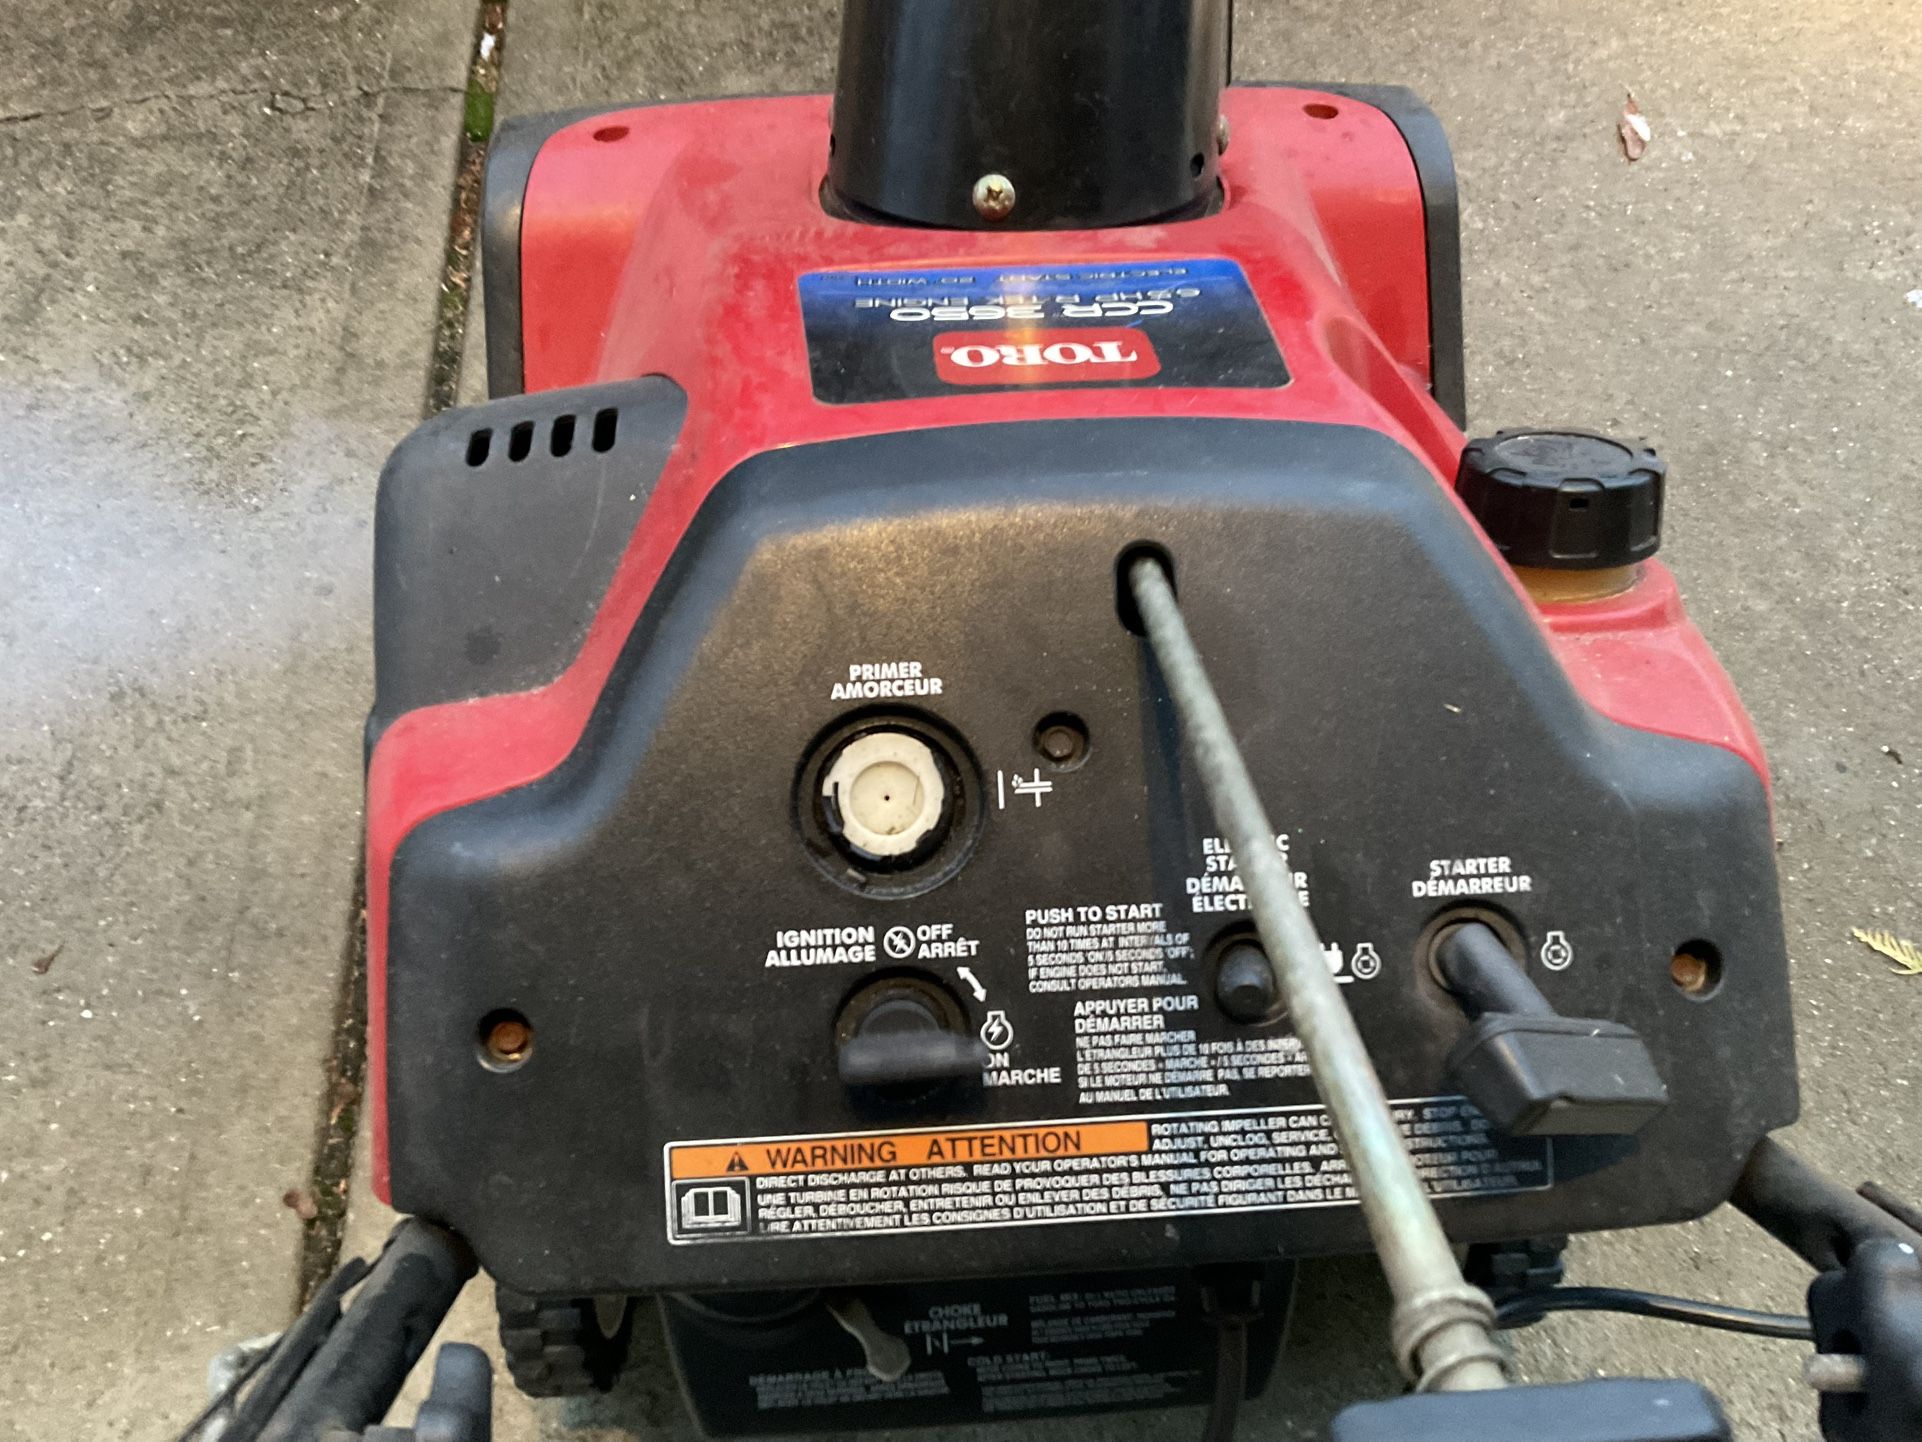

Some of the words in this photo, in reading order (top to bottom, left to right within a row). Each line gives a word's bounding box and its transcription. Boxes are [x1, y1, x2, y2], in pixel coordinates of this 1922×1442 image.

[855, 297, 969, 308] ENGINE
[1061, 300, 1173, 317] CCR
[889, 305, 1045, 321] 3650
[950, 341, 1138, 367] TORO
[849, 662, 922, 681] PRIMER
[830, 678, 943, 700] AMORCEUR
[1429, 856, 1512, 877] STARTER
[1412, 873, 1532, 898] DÉMARREUR
[1025, 908, 1075, 925] PUSH
[1077, 906, 1103, 922] TO
[1105, 903, 1164, 921] START
[776, 926, 875, 949] IGNITION
[916, 924, 954, 942] OFF
[1026, 927, 1042, 940] DO
[1043, 926, 1064, 939] NOT
[1066, 924, 1088, 938] RUN
[1089, 922, 1136, 937] STARTER
[1137, 921, 1167, 935] MORE
[764, 942, 877, 967] ALLUMAGE
[917, 937, 980, 960] ARRÊT
[1027, 940, 1055, 953] THAN
[1057, 939, 1068, 951] 10
[1069, 937, 1099, 951] TIMES
[1101, 937, 1115, 949] AT
[1175, 932, 1190, 946] OF
[1036, 951, 1085, 967] SECONDS
[1115, 947, 1164, 962] SECONDS
[1028, 968, 1038, 980] IF
[1039, 965, 1078, 979] ENGINE
[1078, 963, 1107, 976] DOES
[1108, 962, 1130, 975] NOT
[1029, 979, 1077, 993] CONSULT
[1074, 998, 1149, 1017] APPUYER
[1153, 995, 1199, 1012] POUR
[1075, 1014, 1165, 1034] DÉMARRER
[1092, 1034, 1113, 1047] PAS
[1114, 1033, 1144, 1046] FAIRE
[1145, 1030, 1196, 1044] MARCHER
[1211, 1041, 1235, 1055] FOIS
[1101, 1059, 1156, 1074] SECONDES
[983, 1069, 1062, 1088] MARCHE
[1090, 1075, 1103, 1087] LE
[1104, 1072, 1147, 1086] MOTEUR
[1079, 1091, 1093, 1104] AU
[1095, 1088, 1138, 1103] MANUEL
[1139, 1087, 1153, 1100] DE
[1151, 1120, 1219, 1136] ROTATING
[1221, 1116, 1287, 1132] IMPELLER
[1289, 1114, 1317, 1128] CAN
[766, 1141, 898, 1169] WARNING
[926, 1130, 1082, 1161] ATTENTION
[755, 1175, 805, 1189] DIRECT
[807, 1170, 886, 1186] DISCHARGE
[888, 1169, 906, 1181] AT
[908, 1165, 968, 1182] OTHERS.
[973, 1162, 1012, 1177] READ
[1013, 1160, 1051, 1175] YOUR
[1141, 1152, 1197, 1167] MANUAL
[1200, 1149, 1229, 1163] FOR
[1230, 1145, 1306, 1162] OPERATING
[1309, 1142, 1339, 1156] AND
[757, 1192, 786, 1207] UNE
[788, 1189, 847, 1205] TURBINE
[849, 1188, 869, 1201] EN
[870, 1183, 939, 1200] ROTATION
[941, 1181, 992, 1196] RISQUE
[993, 1180, 1014, 1193] DE
[1015, 1174, 1100, 1191] PROVOQUER
[1102, 1172, 1130, 1186] DES
[1132, 1167, 1212, 1184] BLESSURES
[1213, 1161, 1315, 1179] CORPORELLES.
[910, 1194, 993, 1212] ENTRETENIR
[995, 1193, 1016, 1207] OU
[1017, 1189, 1080, 1205] ENLEVER
[1082, 1187, 1110, 1201] DES
[1170, 1182, 1190, 1196] NE
[1191, 1180, 1219, 1195] PAS
[1220, 1177, 1275, 1193] DIRIGER
[1277, 1174, 1303, 1189] LES
[792, 1214, 902, 1233] ATTENTIVEMENT
[904, 1212, 930, 1226] LES
[932, 1207, 1012, 1225] CONSIGNES
[1013, 1202, 1107, 1219] D'UTILISATION
[1109, 1200, 1127, 1214] ET
[1128, 1199, 1147, 1212] DE
[1218, 1189, 1284, 1206] FIGURANT
[1286, 1187, 1324, 1202] DANS
[1325, 1186, 1343, 1200] LE
[928, 1303, 983, 1320] CHOKE
